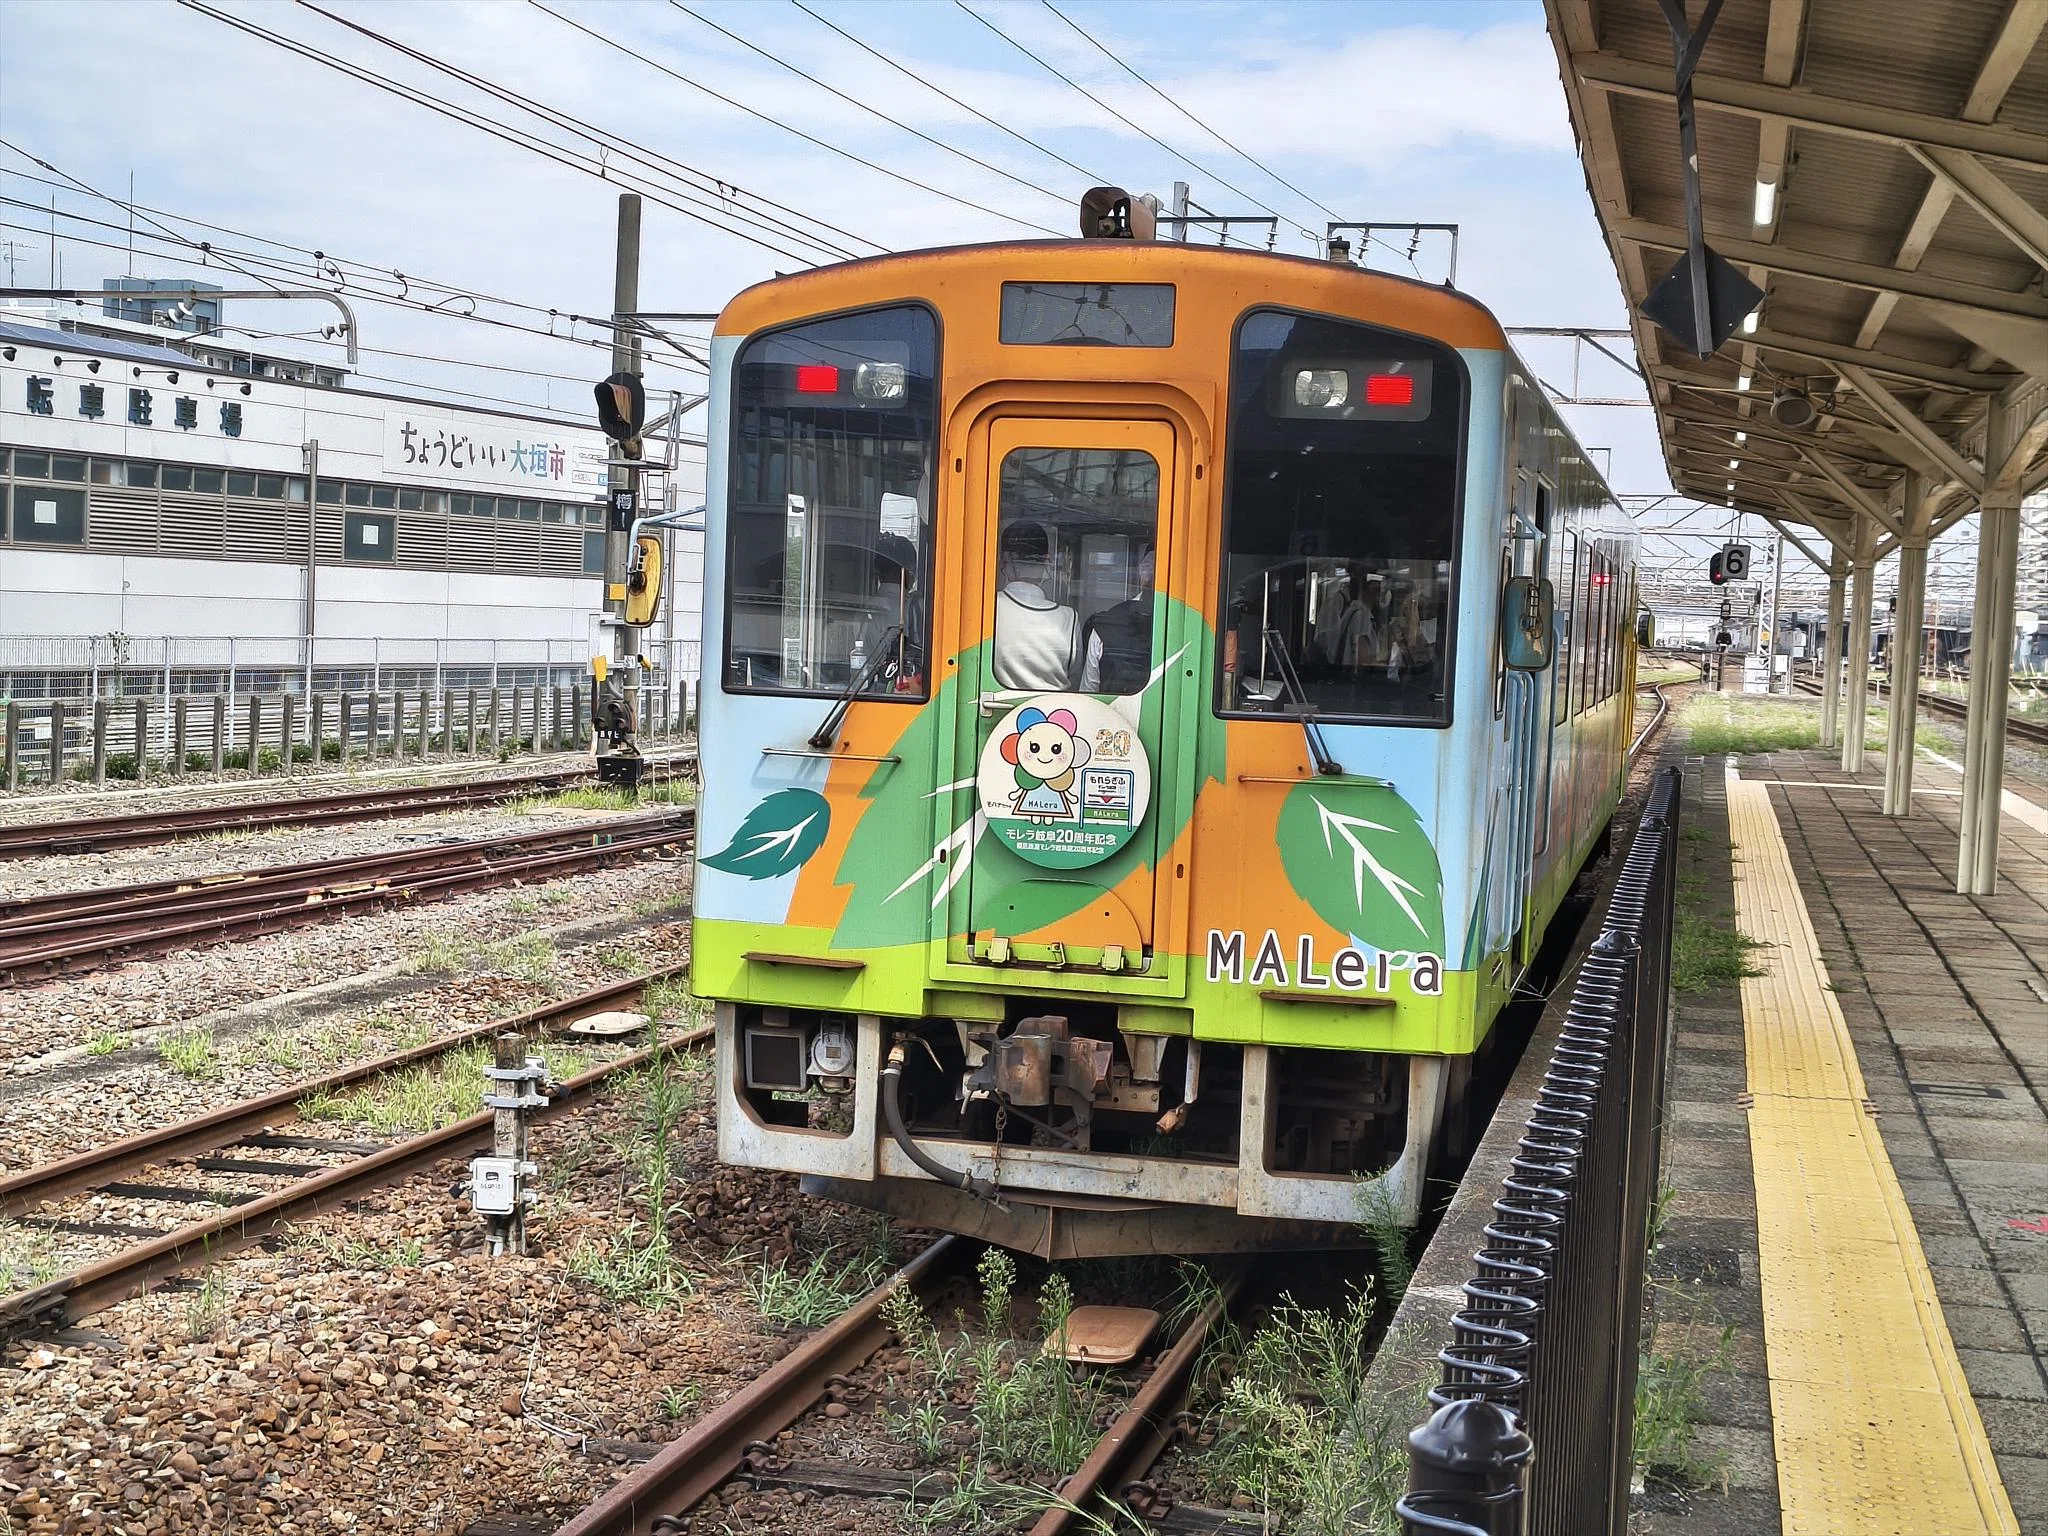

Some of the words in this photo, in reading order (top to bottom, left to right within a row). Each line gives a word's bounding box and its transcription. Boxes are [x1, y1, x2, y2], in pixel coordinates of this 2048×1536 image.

[400, 421, 566, 481] ちょうどいい大垣市
[1726, 549, 1745, 574] 6
[1094, 728, 1131, 757] 20
[1028, 800, 1058, 809] MALera
[1005, 828, 1117, 846] モレラ岐阜20周年記念
[1207, 930, 1443, 995] MALera
